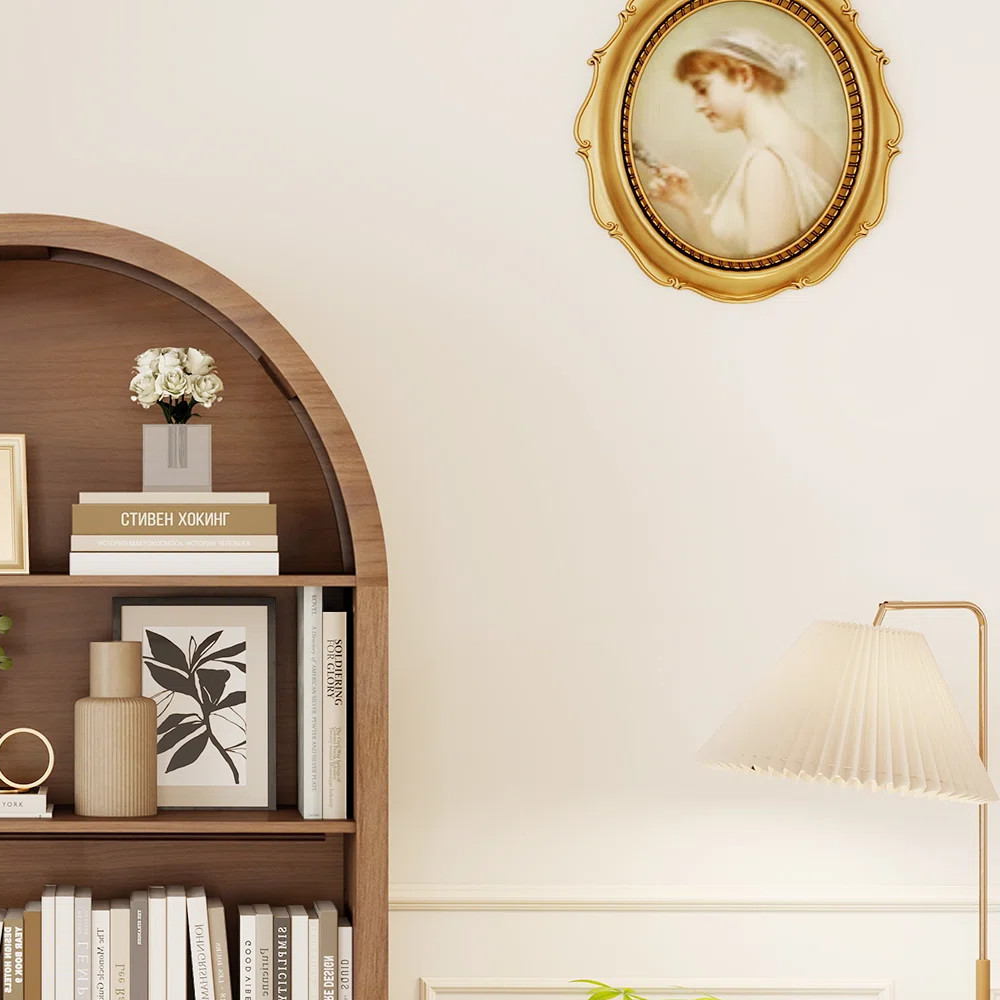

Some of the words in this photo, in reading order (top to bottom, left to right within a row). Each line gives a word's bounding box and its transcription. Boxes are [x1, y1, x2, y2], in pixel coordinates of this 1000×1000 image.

[120, 512, 174, 527] СТИВЕН
[177, 512, 231, 527] ХОКИНГ
[327, 640, 335, 660] FOR
[327, 663, 335, 698] GLORY
[335, 639, 343, 706] SOLDIERING
